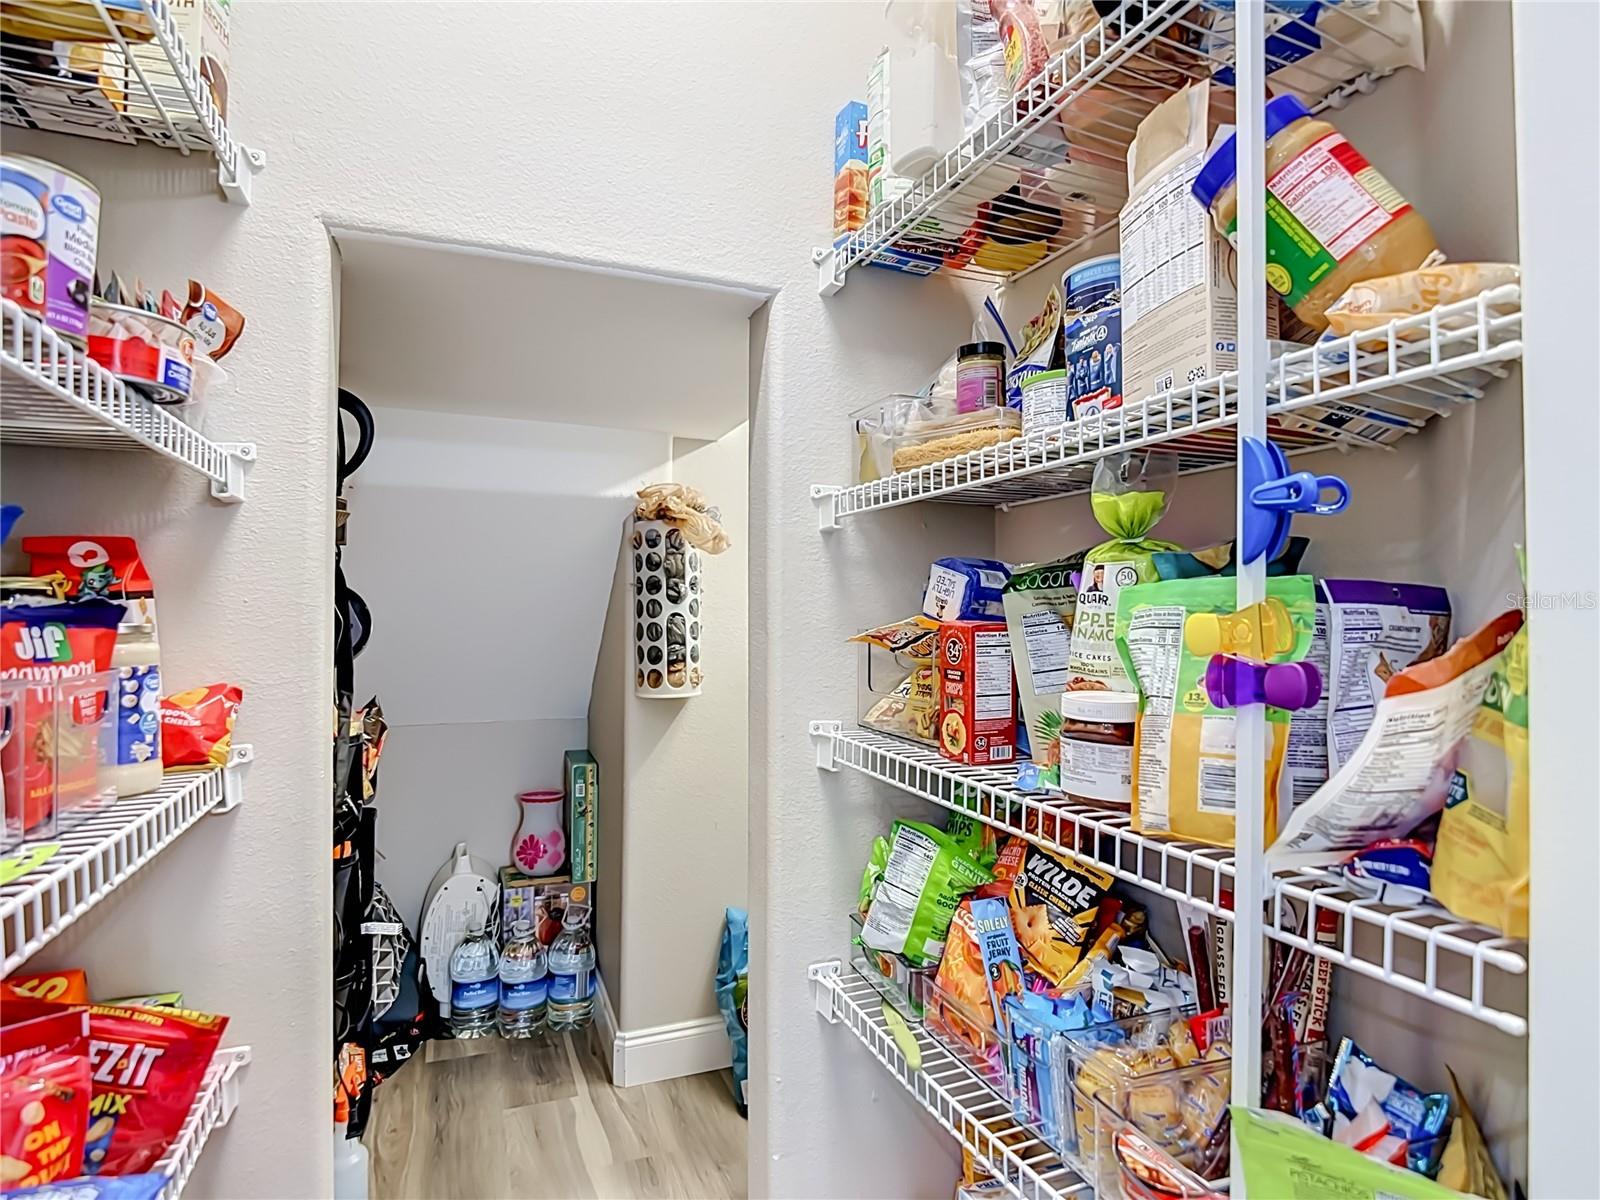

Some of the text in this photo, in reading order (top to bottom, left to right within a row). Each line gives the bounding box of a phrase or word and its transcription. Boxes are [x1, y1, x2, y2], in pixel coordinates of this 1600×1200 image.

[1268, 160, 1303, 190] Nutrition
[1320, 161, 1339, 178] 190
[1285, 179, 1318, 207] Calories
[1120, 571, 1133, 581] 50
[14, 625, 65, 661] Jif
[1085, 652, 1112, 662] CAKES
[900, 826, 925, 841] Nutrition
[1026, 853, 1097, 909] WILDE
[1028, 871, 1051, 891] PROTEIN
[977, 915, 1008, 934] SOLELY
[986, 938, 1009, 950] FRUIT
[988, 947, 1012, 961] JERKY
[1312, 987, 1328, 1027] STICK
